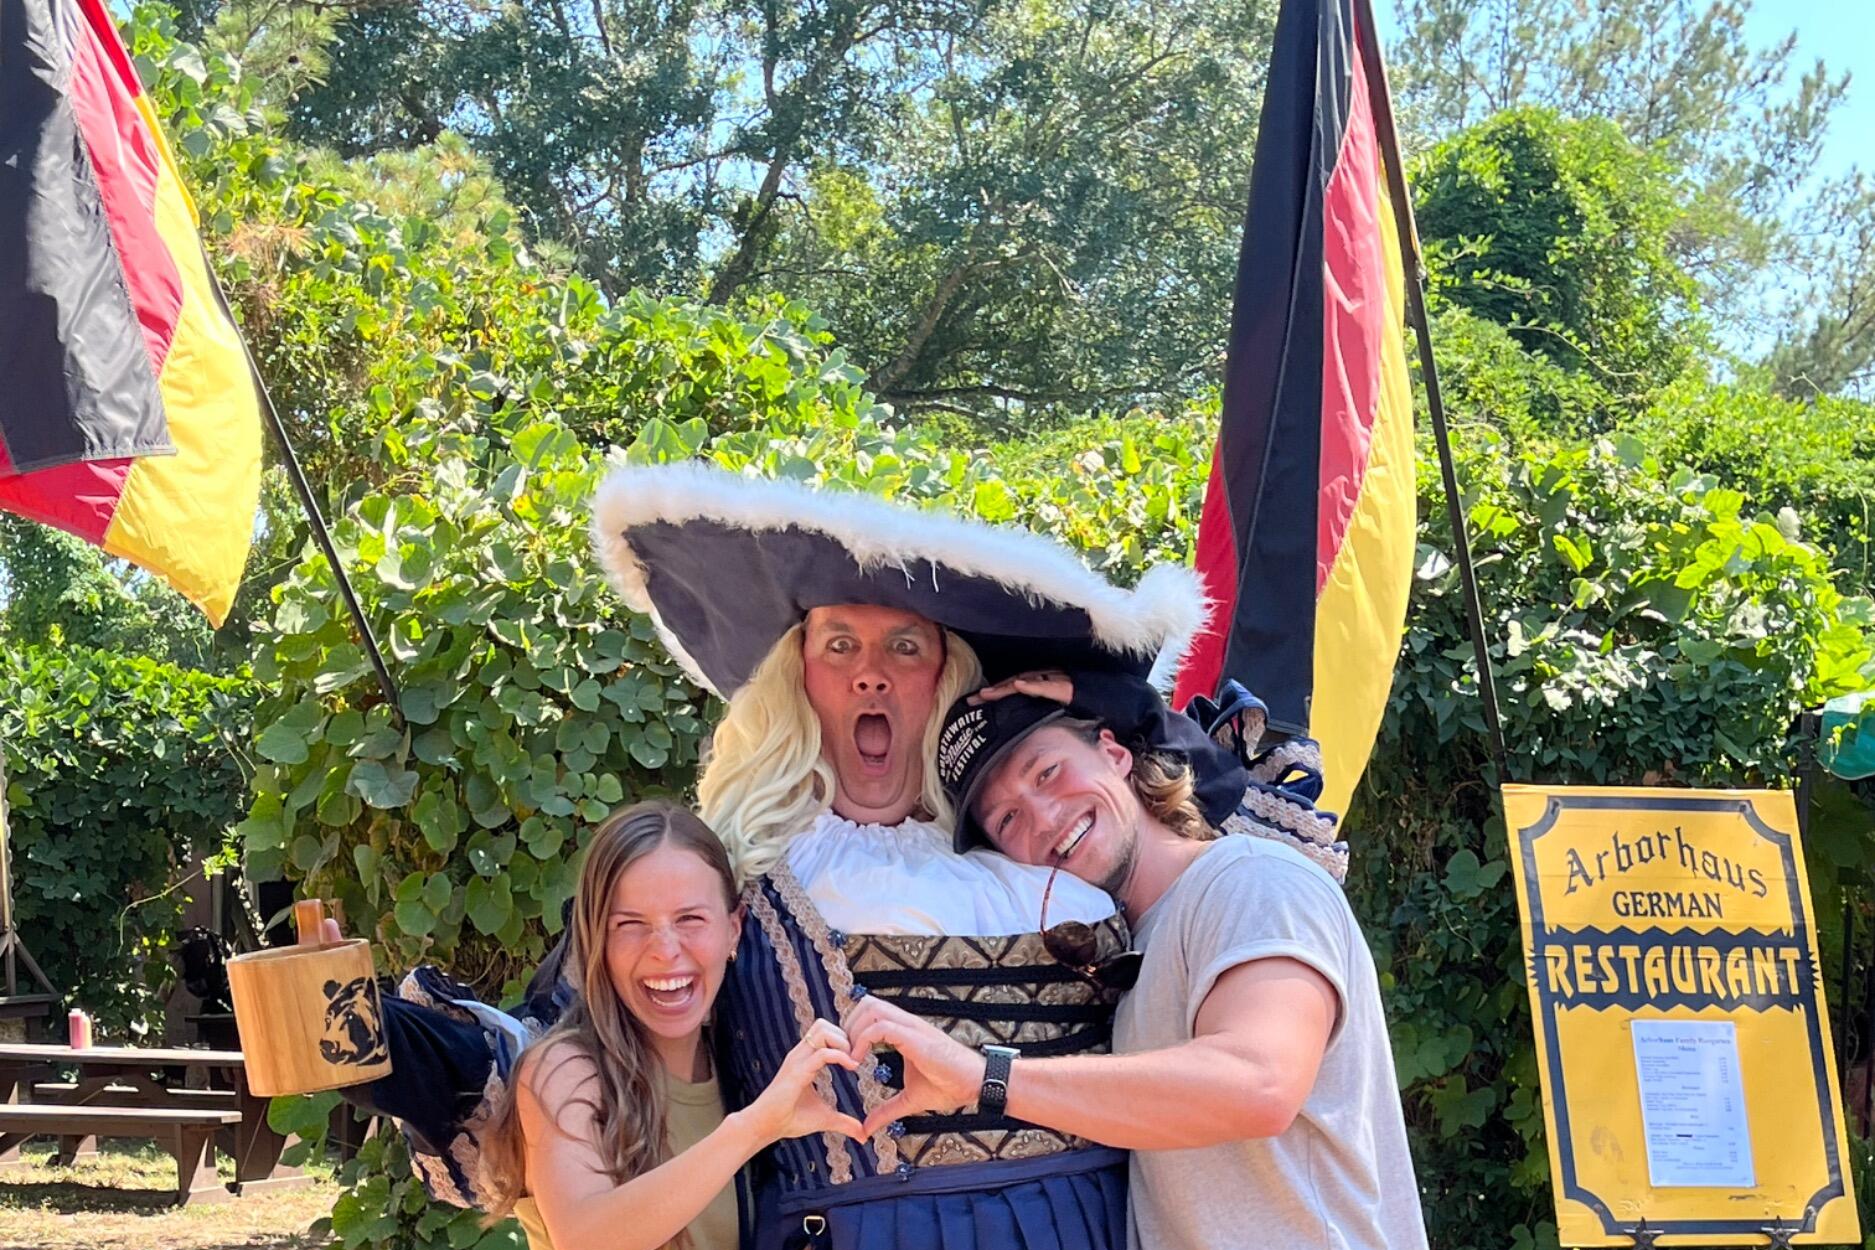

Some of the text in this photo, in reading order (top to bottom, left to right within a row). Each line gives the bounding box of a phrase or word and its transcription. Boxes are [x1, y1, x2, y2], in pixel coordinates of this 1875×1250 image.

[952, 735, 987, 781] FESTIVAL
[1564, 826, 1768, 898] Arborhaus
[1612, 890, 1724, 919] GERMAN
[1544, 944, 1801, 1000] RESTAURANT
